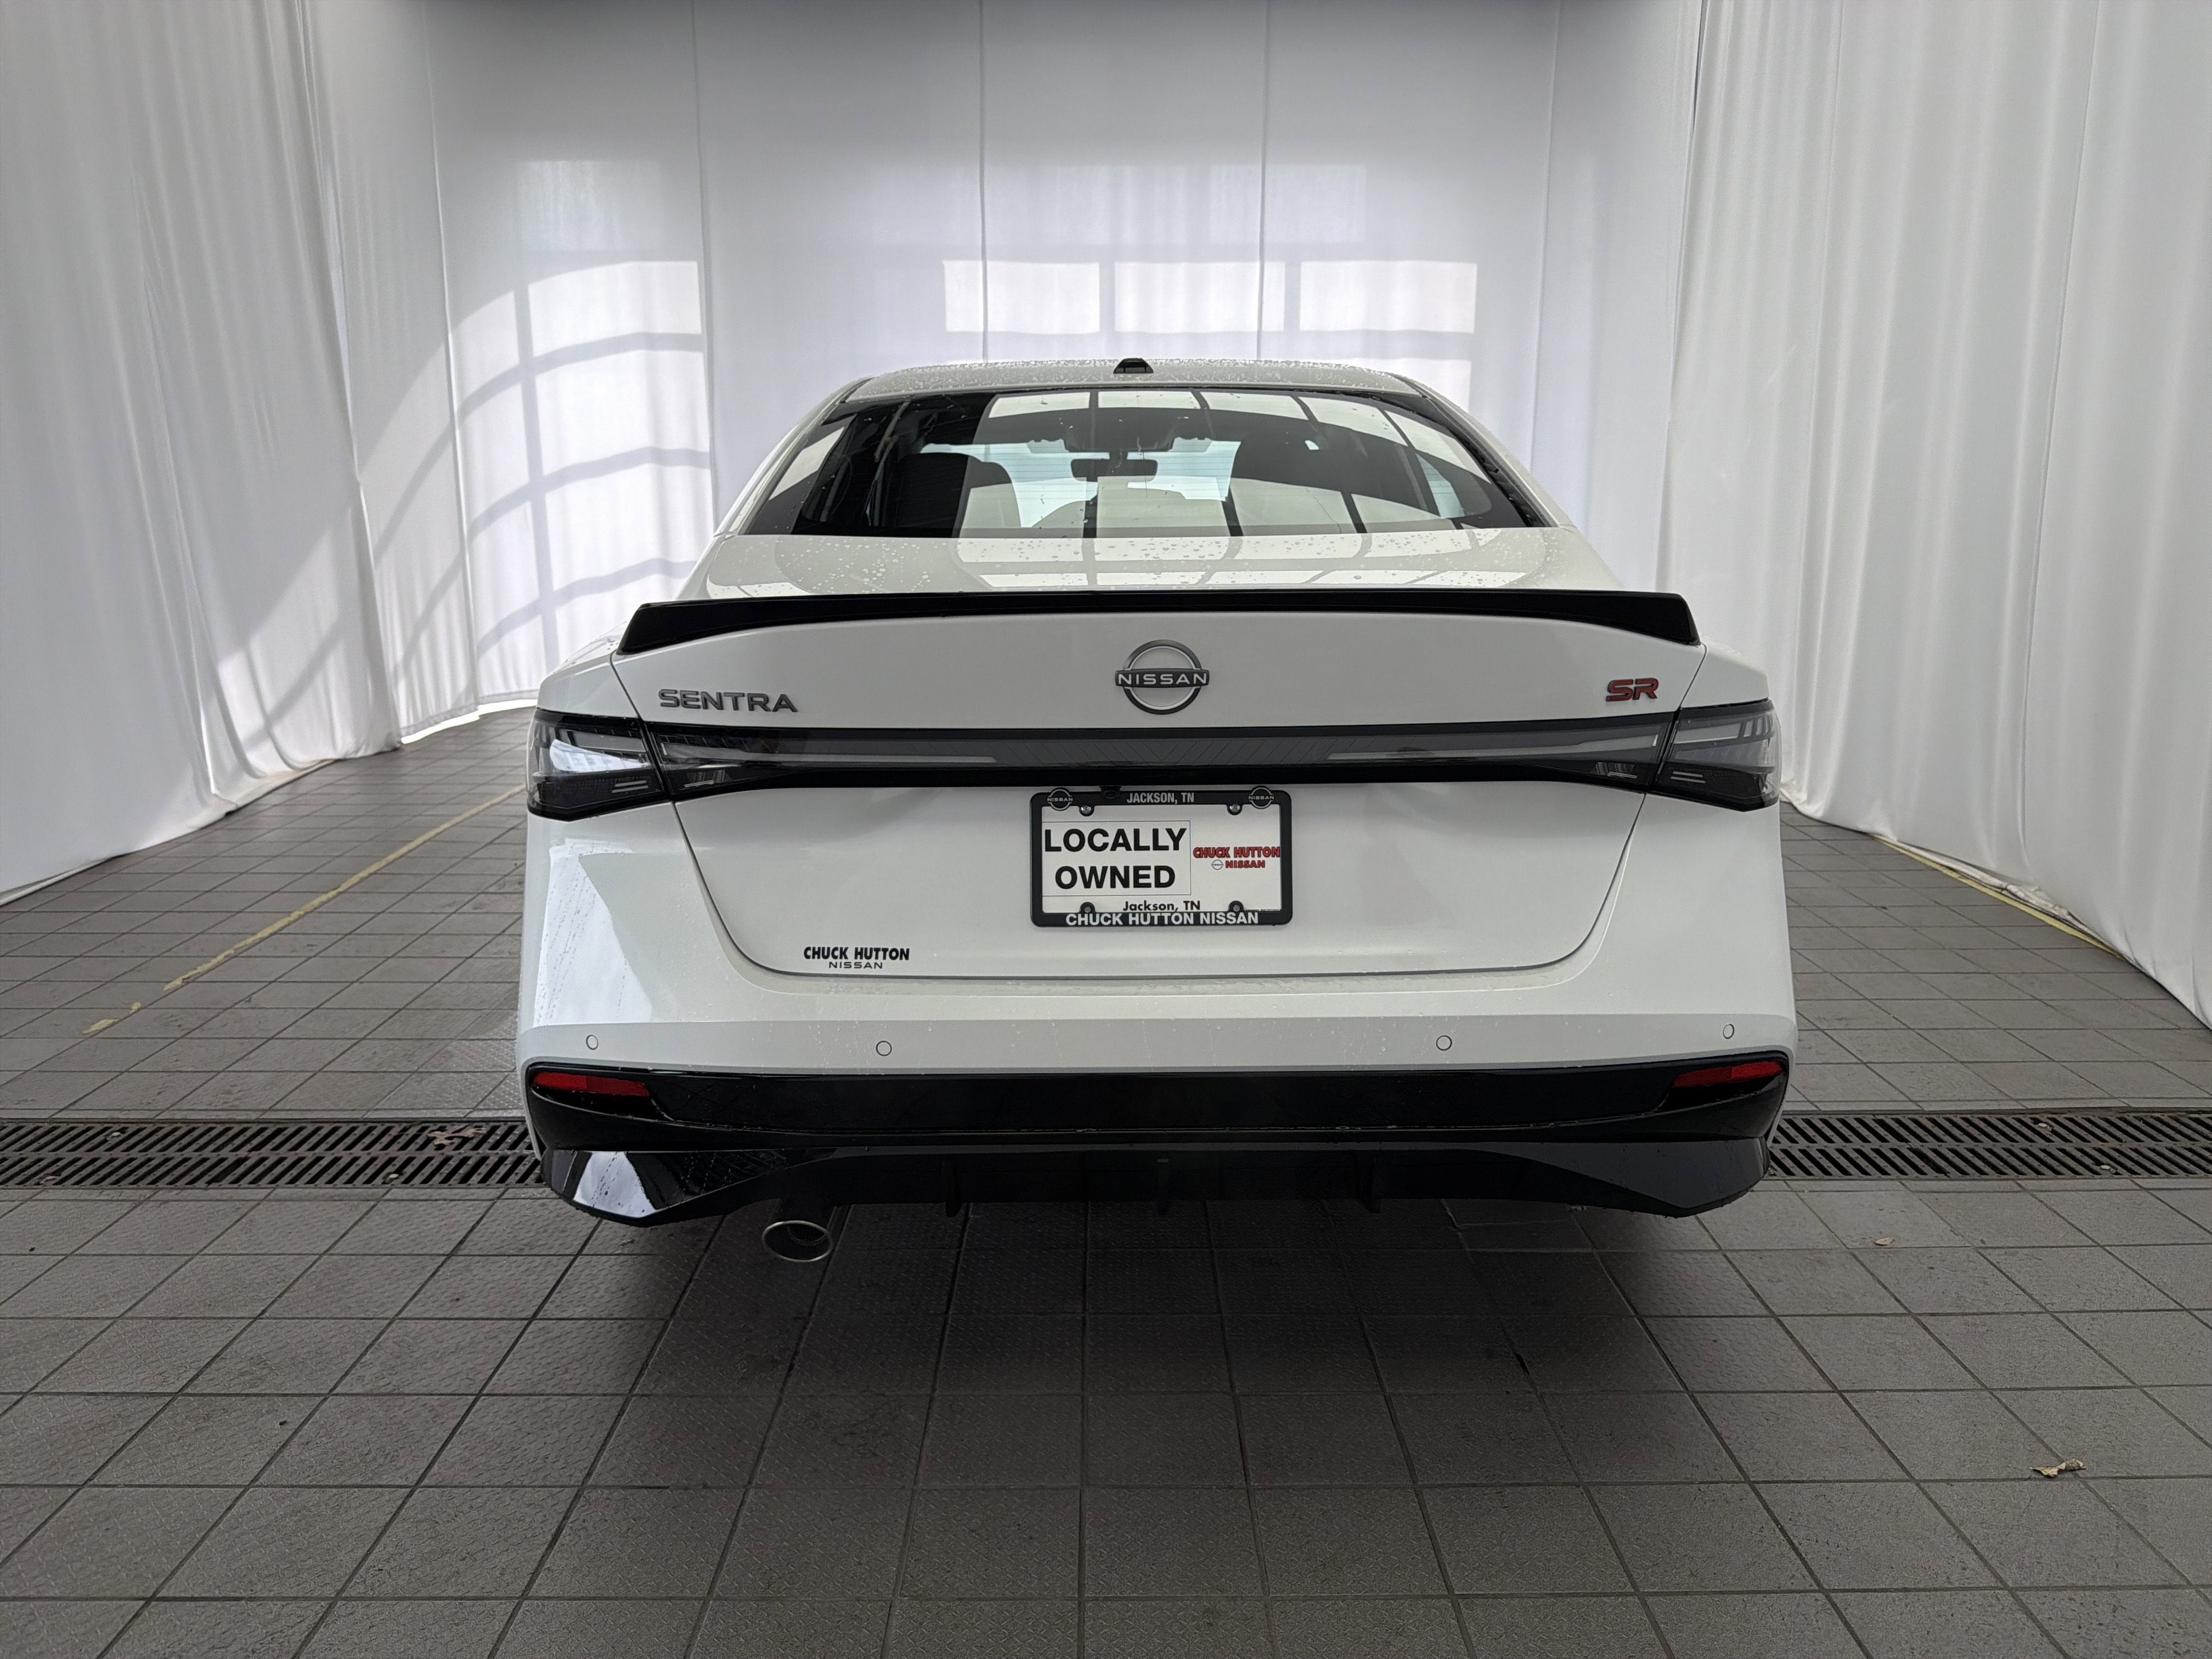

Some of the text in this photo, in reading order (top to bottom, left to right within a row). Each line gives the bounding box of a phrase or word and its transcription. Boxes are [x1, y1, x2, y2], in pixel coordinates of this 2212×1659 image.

[1118, 673, 1207, 685] NISSAN
[1606, 678, 1659, 702] SR
[658, 689, 798, 713] SENTRA
[1126, 792, 1194, 805] JACKSON, TN
[1045, 828, 1187, 852] LOCALLY
[1193, 847, 1281, 859] CHUCK HUTTON
[1225, 860, 1266, 868] NISSAN
[1054, 865, 1176, 889] OWNED
[1123, 900, 1200, 912] Jackson, TN
[1065, 912, 1259, 926] CHUCK HUTTON NISSAN
[803, 946, 910, 961] CHUCK HUTTON
[828, 961, 883, 969] NISSAN
